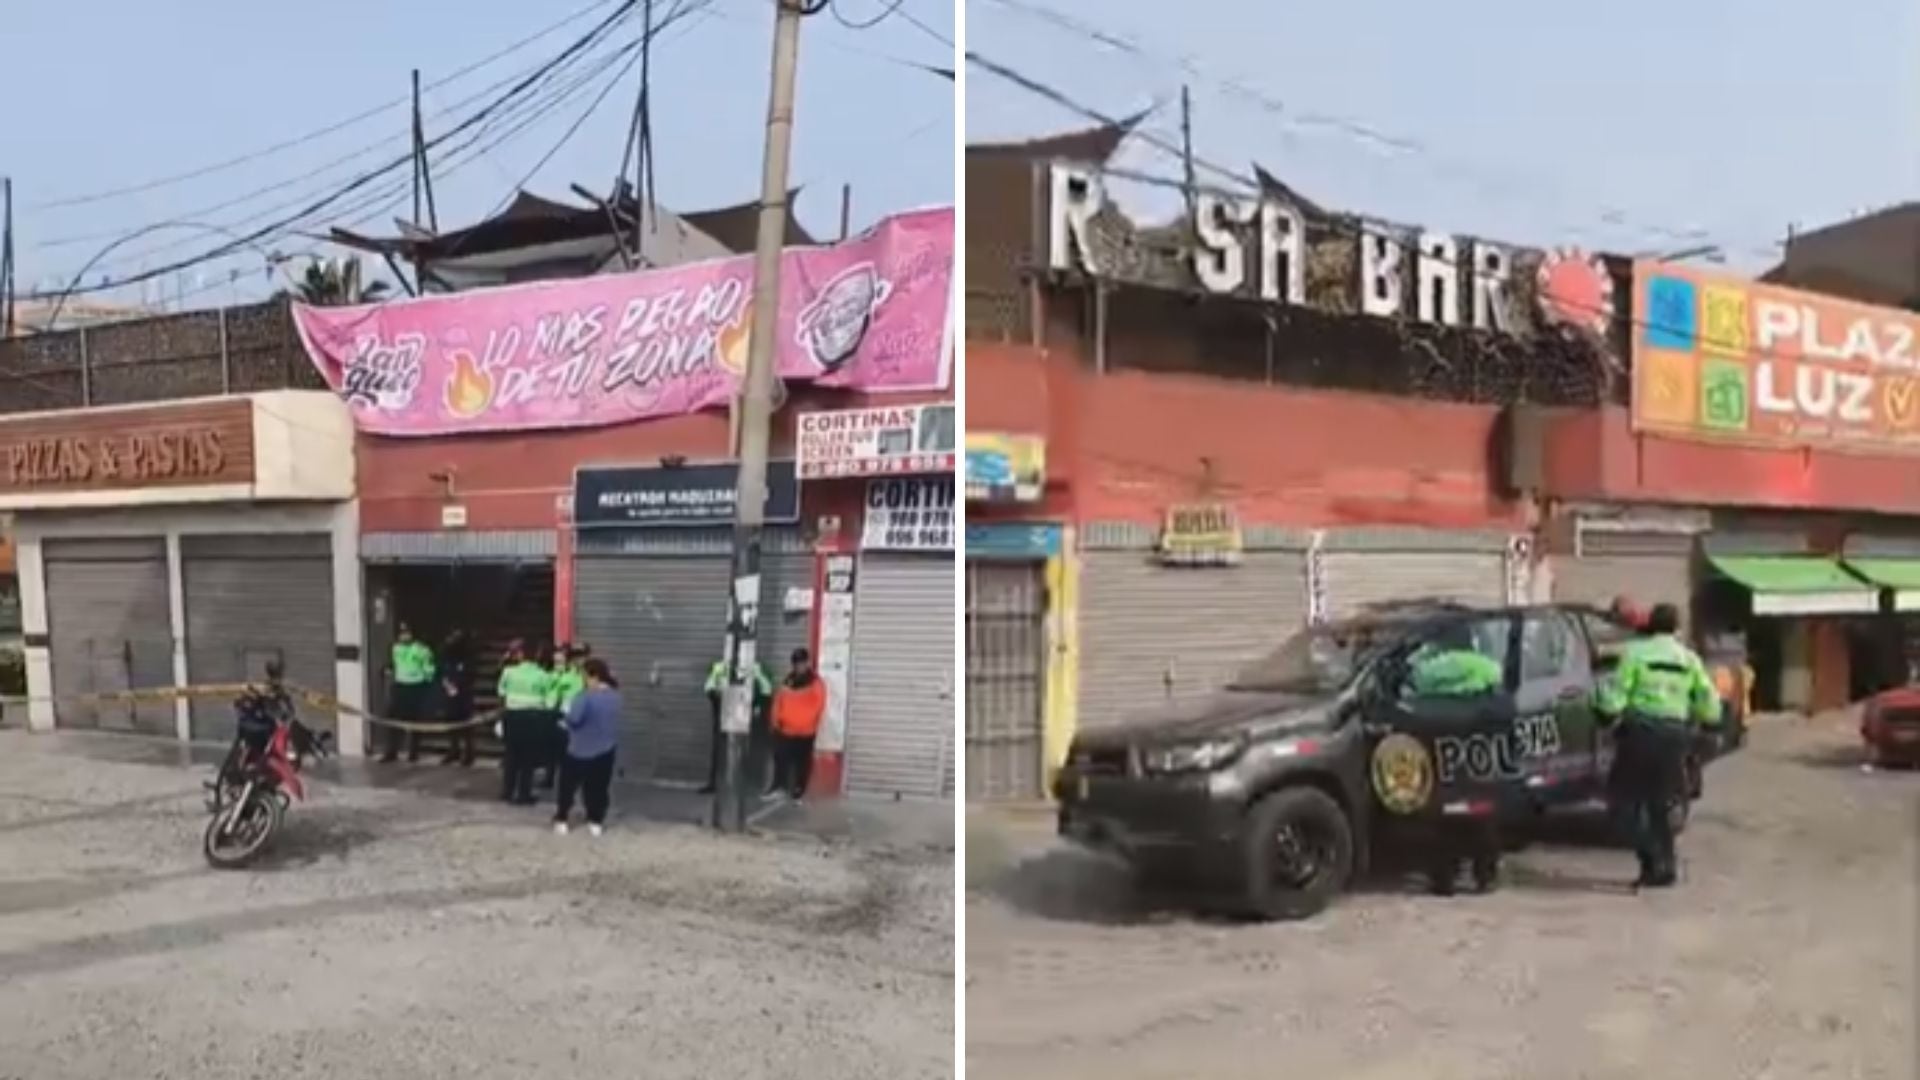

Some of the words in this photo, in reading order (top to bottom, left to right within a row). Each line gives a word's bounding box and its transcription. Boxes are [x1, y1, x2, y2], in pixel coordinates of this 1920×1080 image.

[1360, 220, 1512, 334] BAR
[481, 326, 521, 372] LO
[528, 305, 606, 360] MAS
[495, 364, 549, 408] DE
[548, 354, 598, 398] TU
[603, 328, 716, 392] ZONA
[1756, 300, 1920, 370] PLAZ
[803, 410, 916, 432] CORTINAS
[1756, 360, 1874, 421] LUZ
[10, 438, 92, 484] PIZZAS
[101, 438, 119, 480] &
[128, 430, 226, 480] PASTAS
